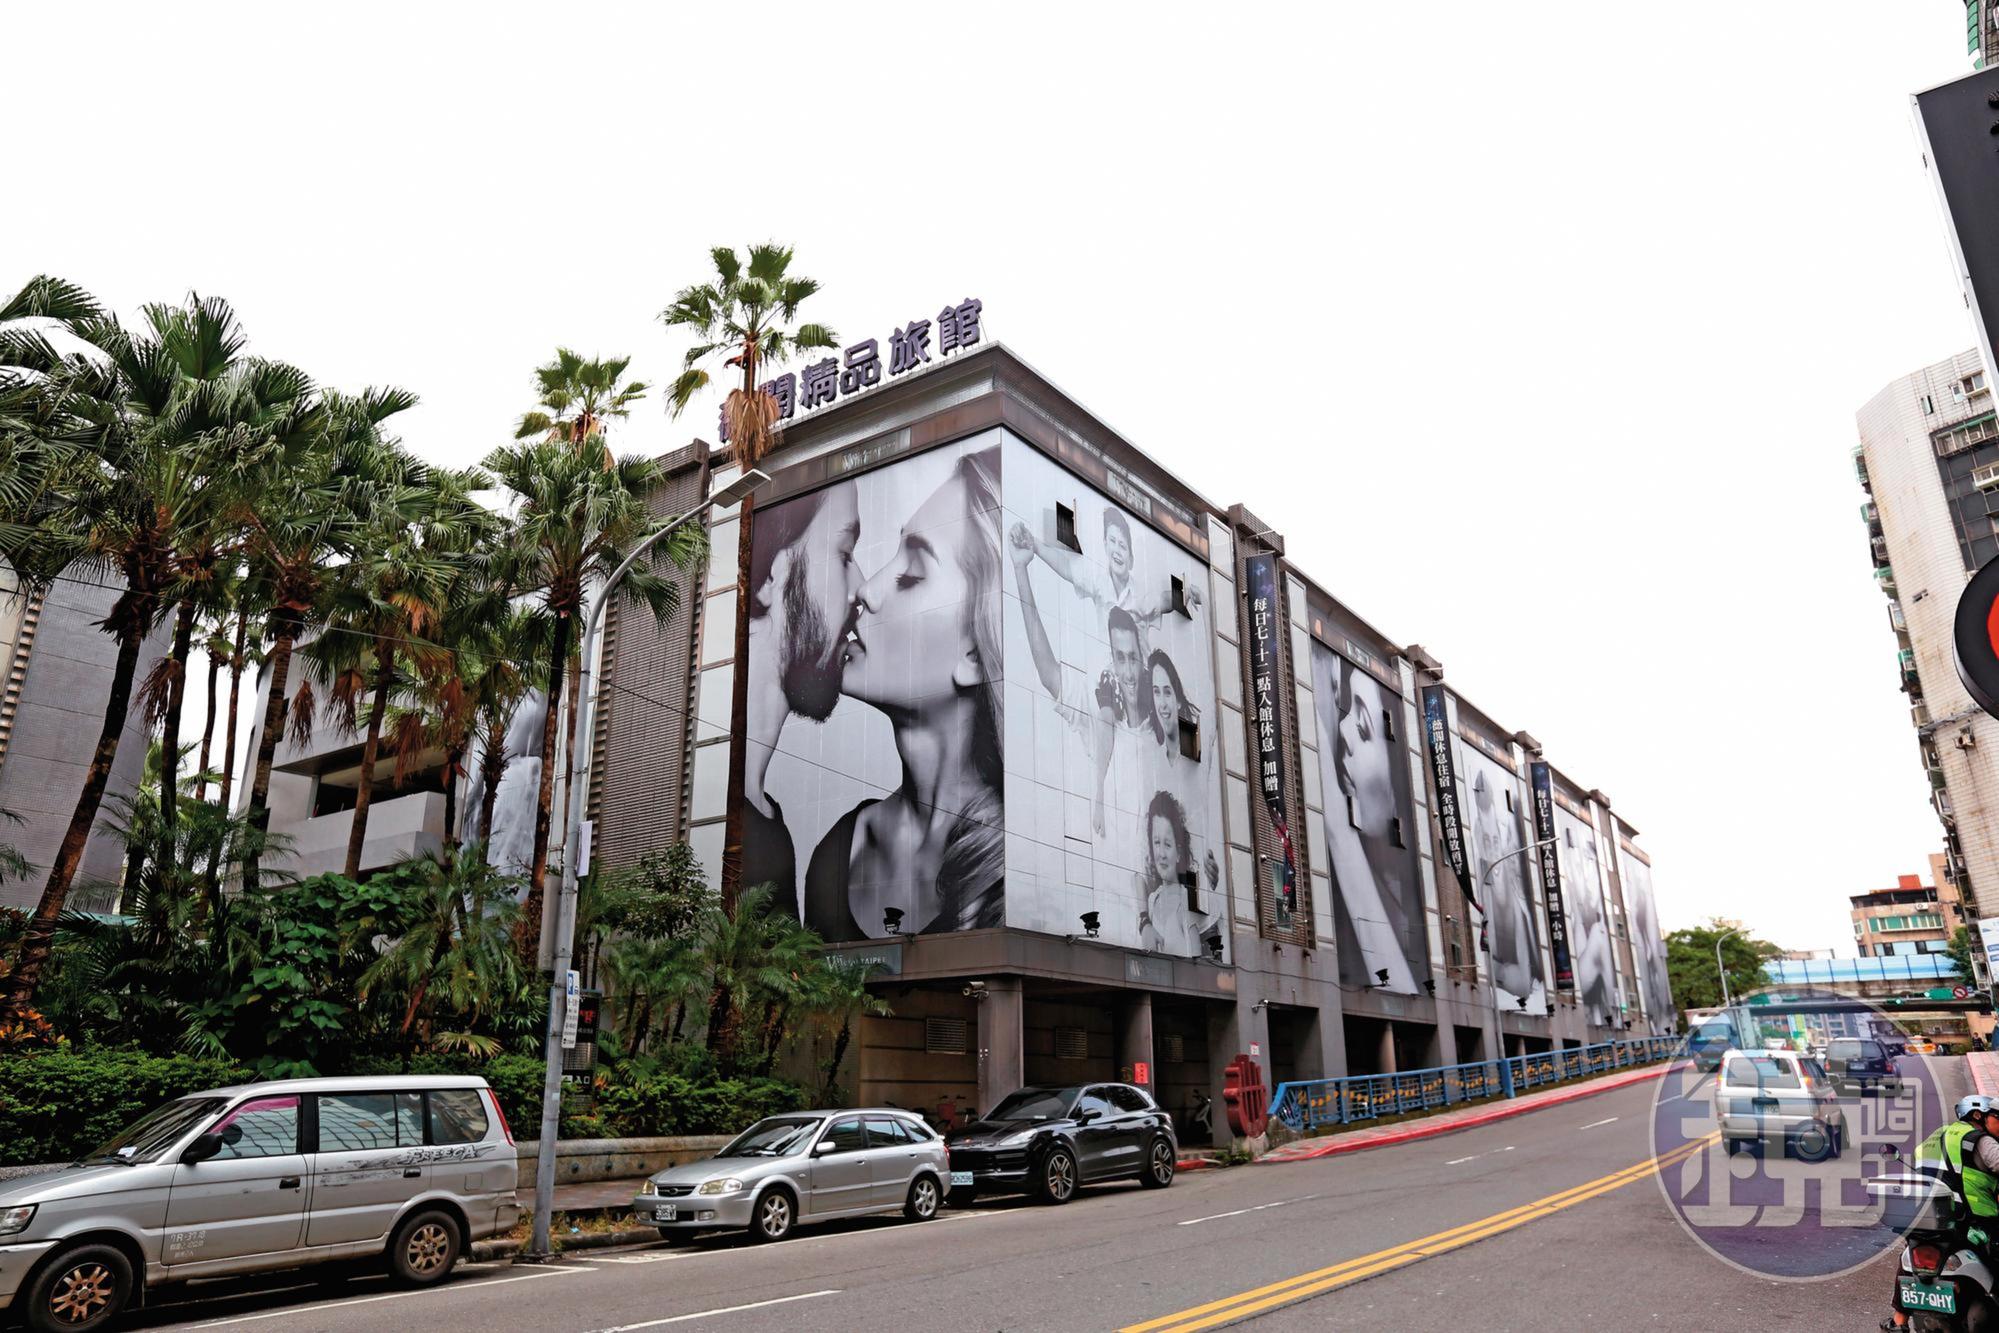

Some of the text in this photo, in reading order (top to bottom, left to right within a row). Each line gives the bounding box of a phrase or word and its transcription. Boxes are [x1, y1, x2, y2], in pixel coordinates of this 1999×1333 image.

[719, 298, 982, 444] 閣精品旅館
[1263, 761, 1281, 816] 加贈一
[1902, 1289, 1952, 1309] 857-QHY
